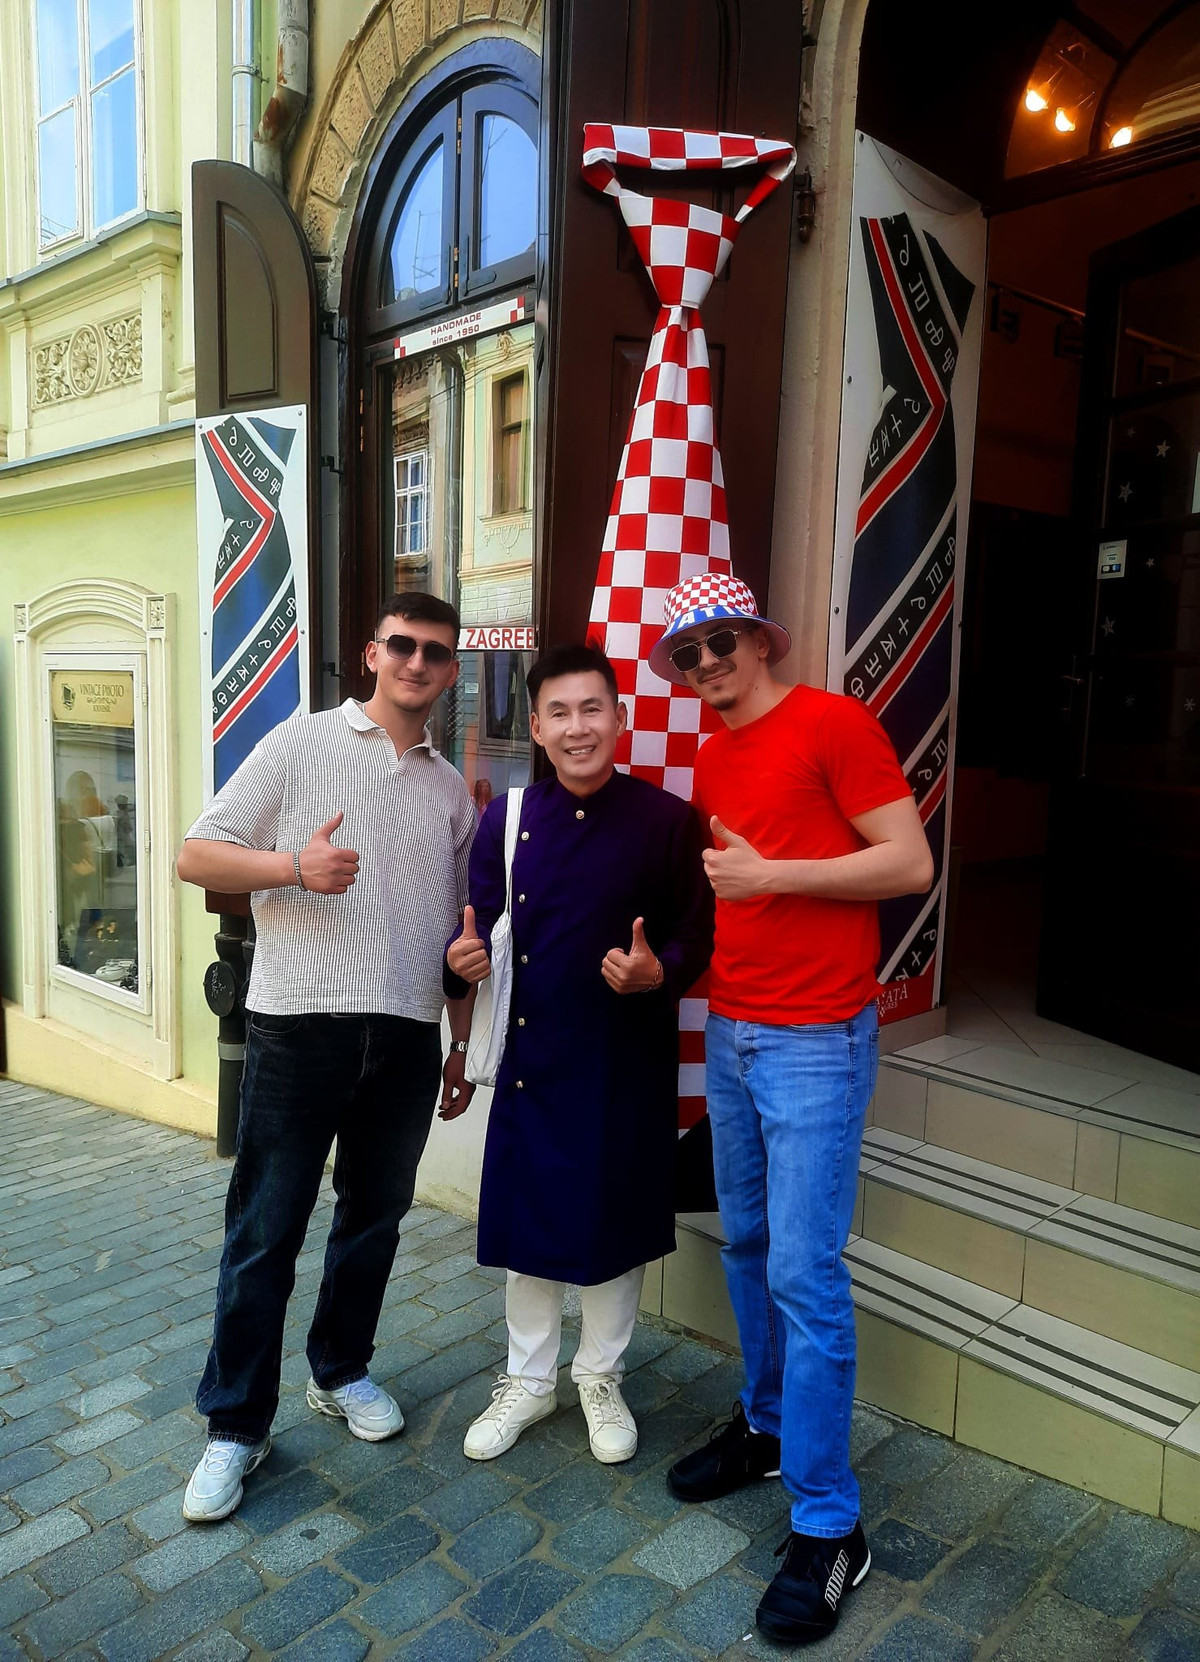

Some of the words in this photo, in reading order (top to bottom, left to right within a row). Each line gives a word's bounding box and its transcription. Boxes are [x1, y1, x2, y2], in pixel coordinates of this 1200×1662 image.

[430, 312, 482, 336] HANDMADE
[432, 335, 453, 346] since
[456, 324, 480, 338] 1950
[102, 684, 125, 698] PHOTO
[824, 1549, 850, 1611] PUMA
